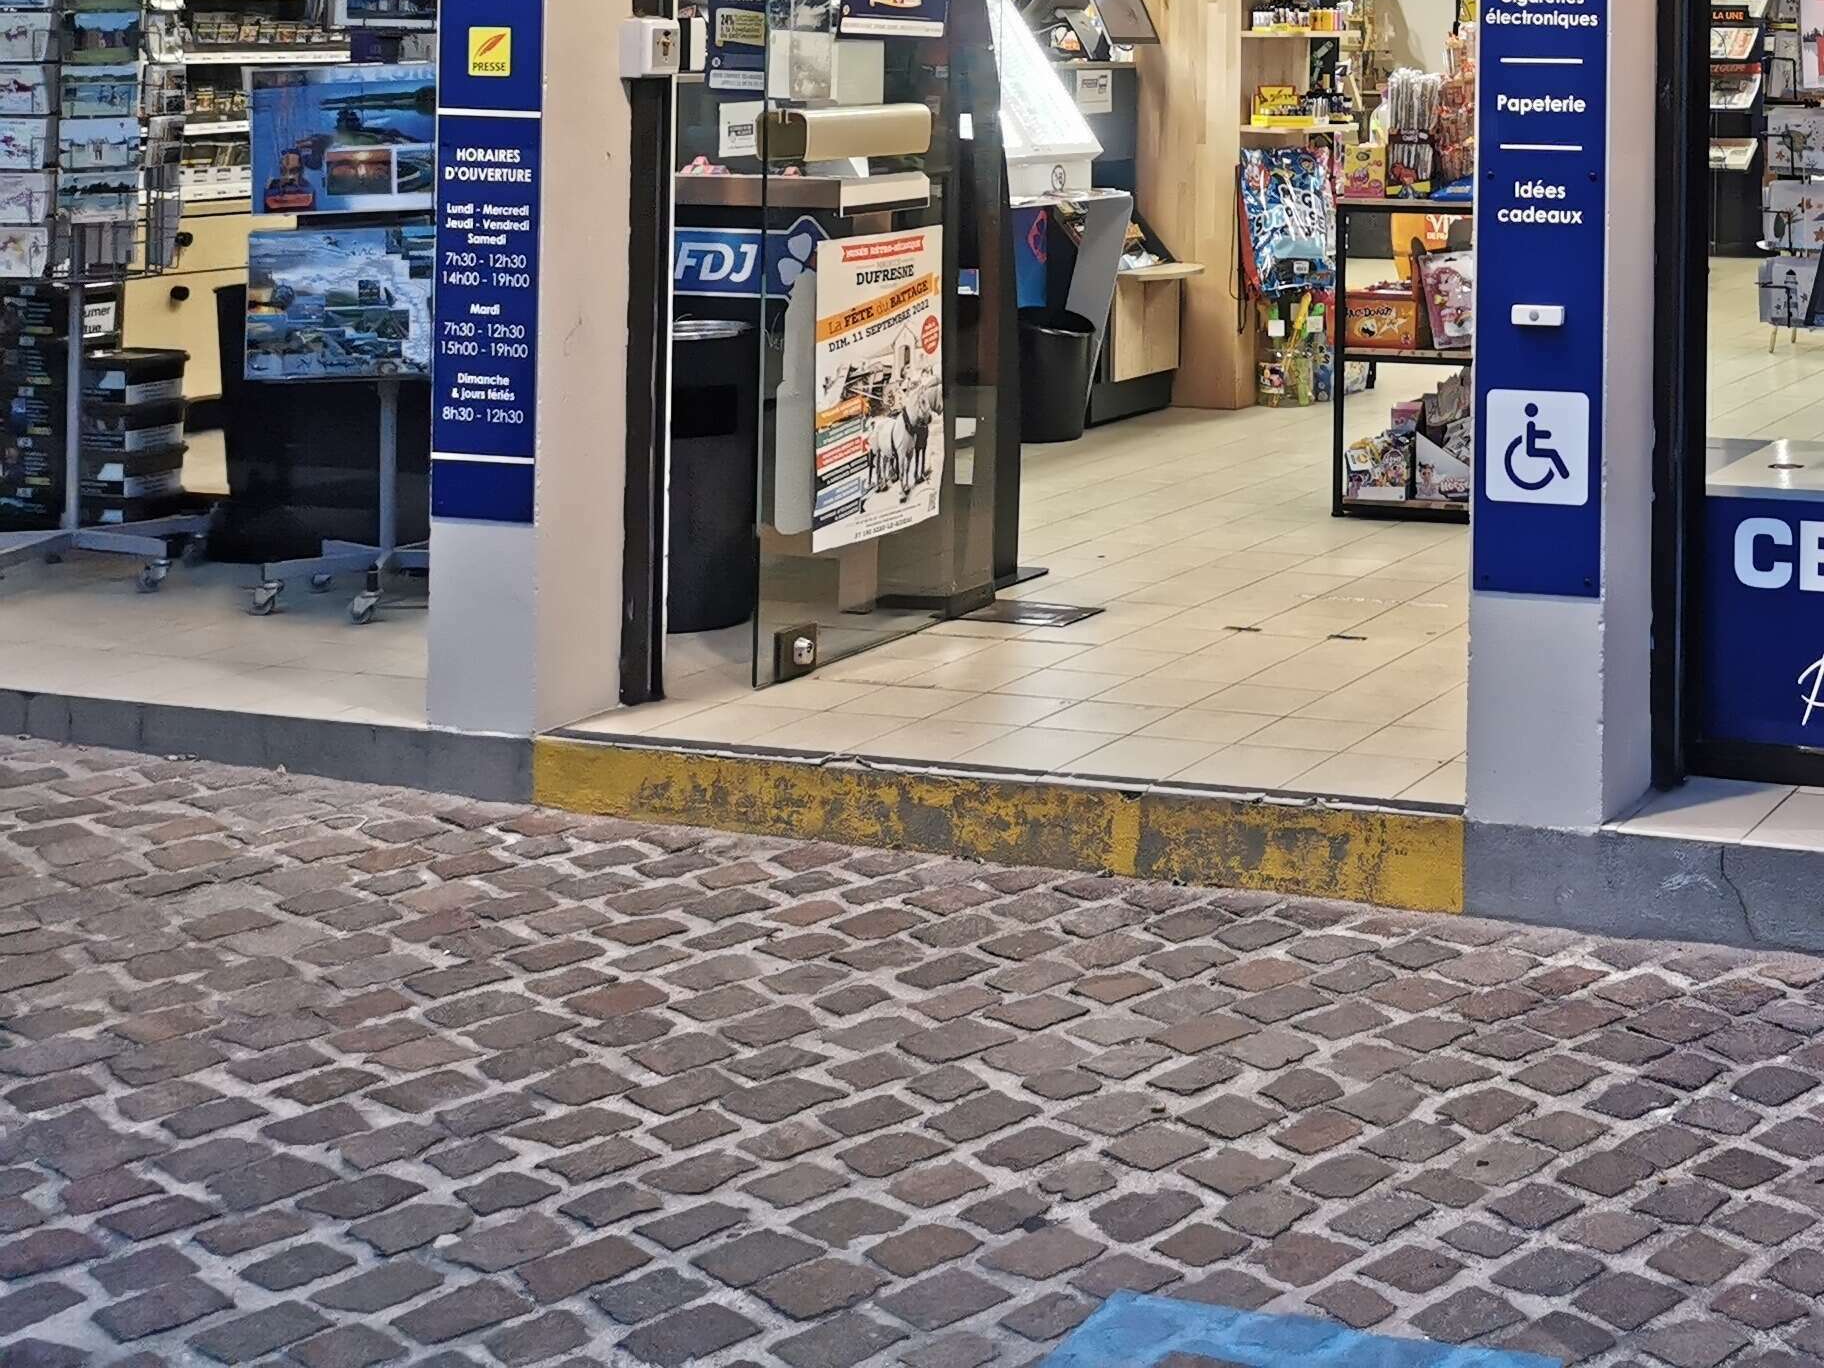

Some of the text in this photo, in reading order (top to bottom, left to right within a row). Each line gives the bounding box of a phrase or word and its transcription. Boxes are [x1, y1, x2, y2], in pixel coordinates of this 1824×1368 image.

[1486, 7, 1598, 28] électroniques
[1712, 11, 1744, 20] LA UNE
[472, 62, 506, 73] PRESSE
[1498, 95, 1585, 115] Papeterie
[457, 148, 520, 163] HORAIRES
[445, 167, 531, 182] D'OUVERTURE
[1515, 180, 1565, 199] Idées
[447, 203, 529, 216] Lundi Mercredi
[1498, 206, 1582, 223] cadeaux
[446, 218, 529, 230] Jeudi Vendredi
[468, 233, 506, 245] Samedi
[446, 252, 526, 268] 7h30 12h30
[674, 242, 758, 282] FDJ
[443, 271, 529, 287] 14h00 19h00
[856, 264, 914, 286] DUFRESNE
[470, 304, 500, 315] Mardi
[844, 308, 875, 328] FÊTE
[445, 322, 524, 339] 7h30 12h30
[828, 337, 850, 353] DIM.
[852, 331, 863, 343] 11
[865, 309, 911, 338] SEPTEMBRE
[442, 341, 528, 358] 15h00 19h00
[458, 373, 509, 385] Dimanche
[452, 388, 515, 400] & jours fériés
[442, 406, 523, 423] 8h30 12h30
